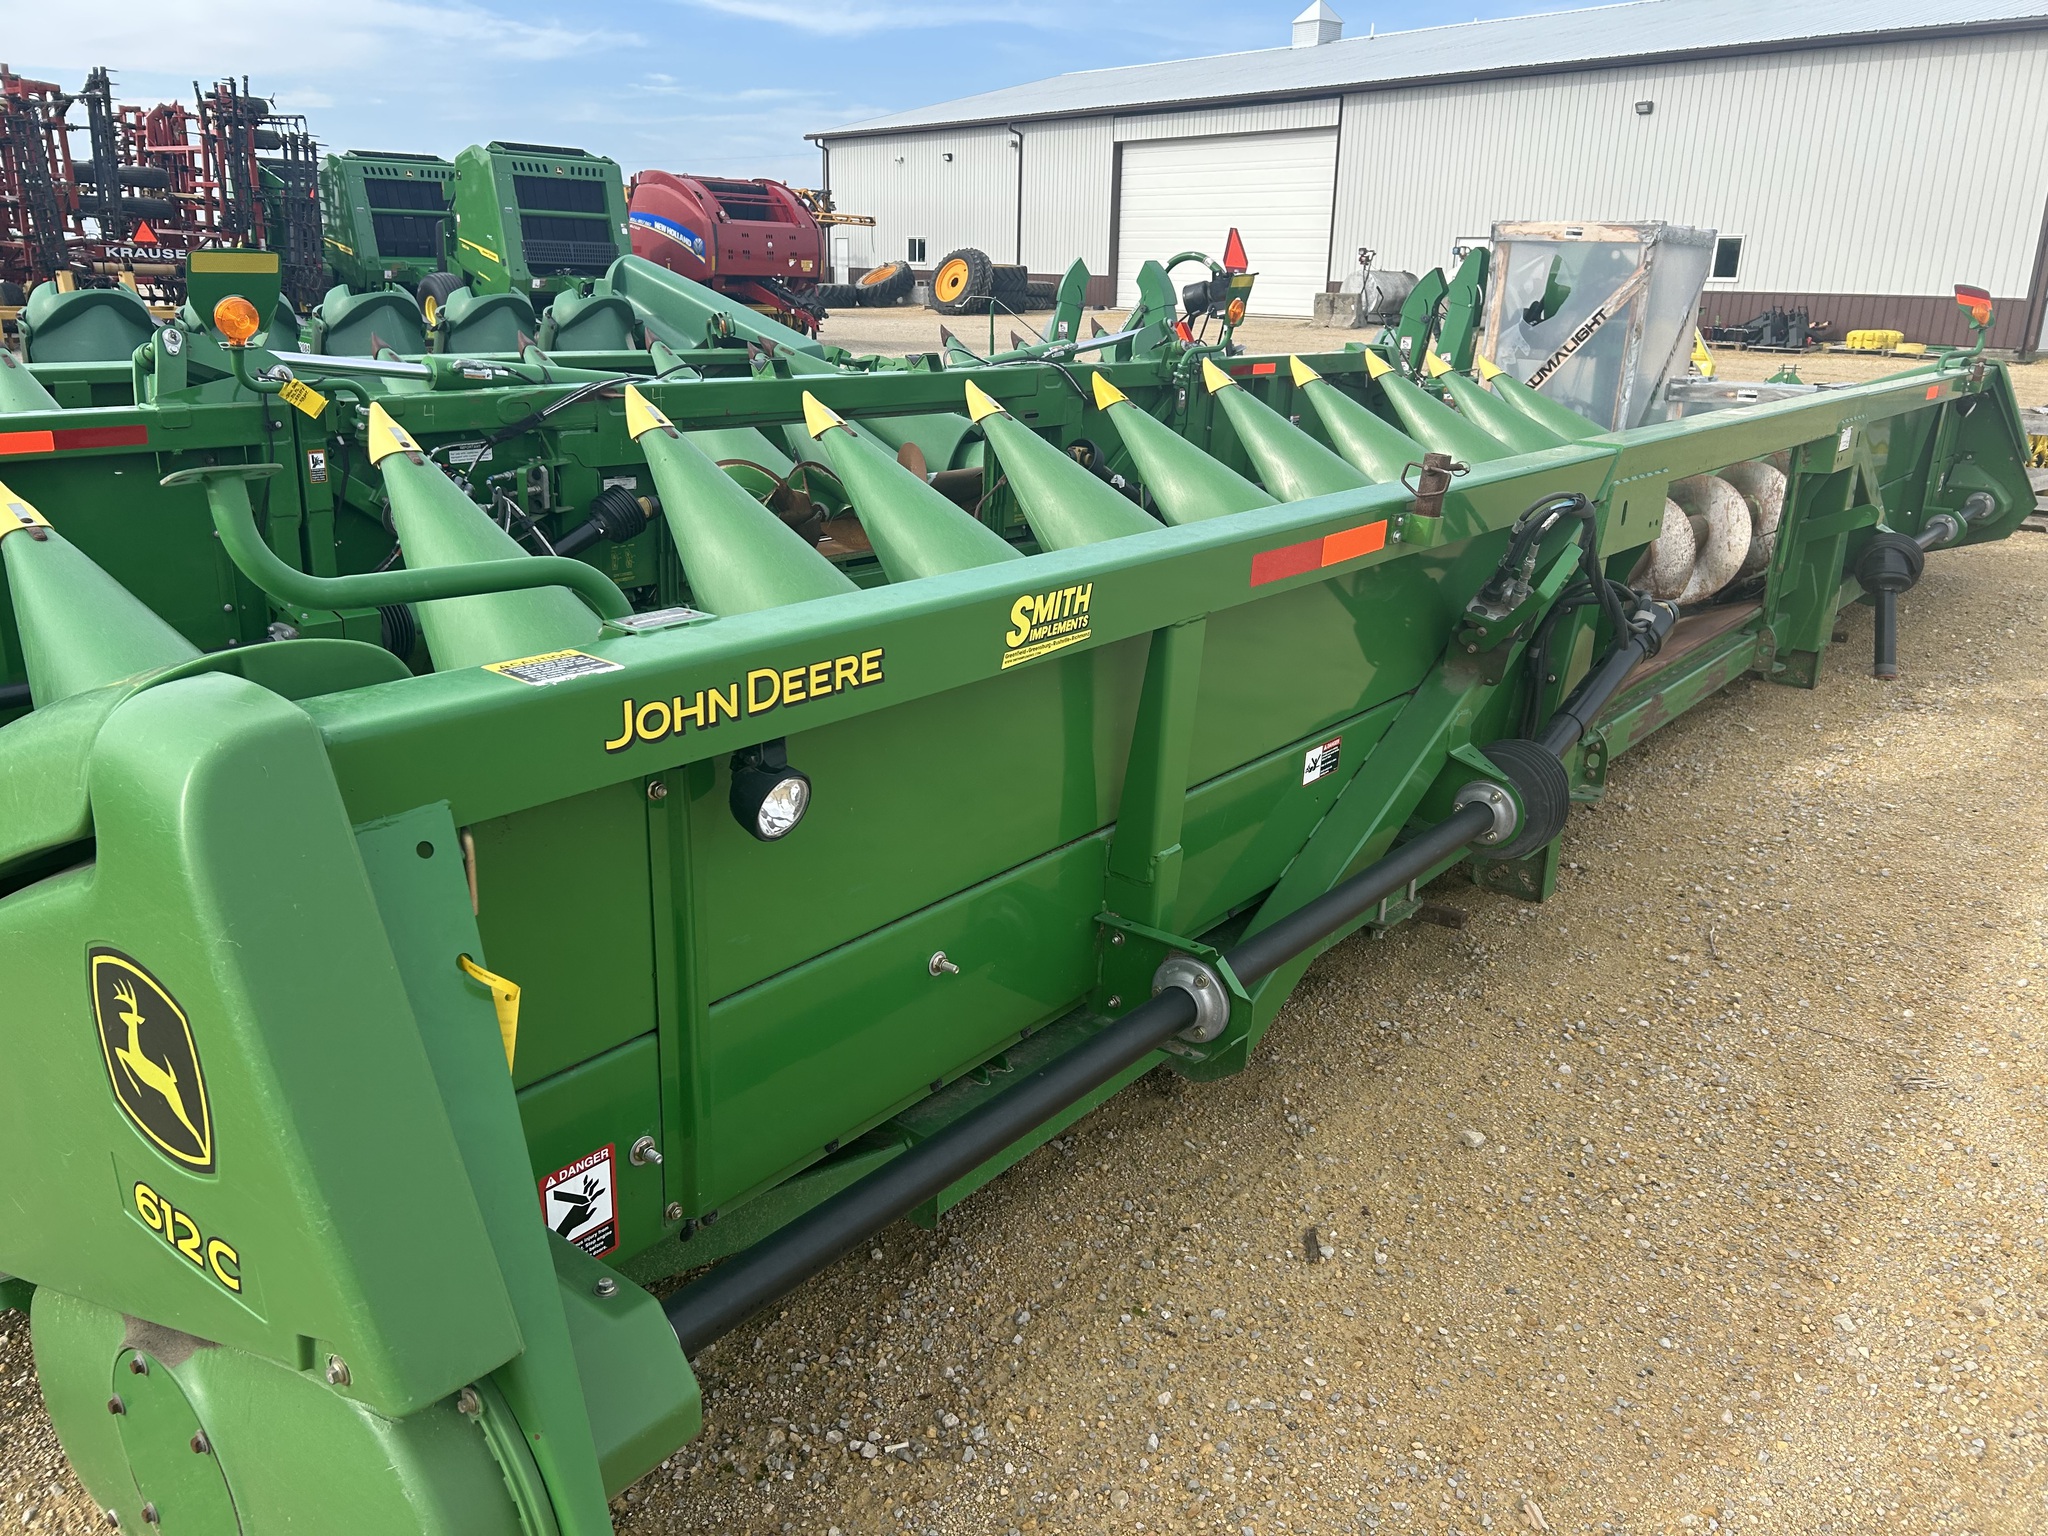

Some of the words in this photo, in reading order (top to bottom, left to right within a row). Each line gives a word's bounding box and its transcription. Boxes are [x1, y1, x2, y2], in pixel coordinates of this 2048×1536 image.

[654, 221, 667, 233] NEW
[666, 227, 692, 247] HOLLAND
[105, 246, 187, 259] KRAUSE
[1006, 582, 1093, 648] SMITH
[1028, 614, 1089, 642] IMPLEMENTS
[605, 683, 740, 752] JOHN
[747, 647, 884, 716] DEERE
[559, 1148, 609, 1181] DANGER
